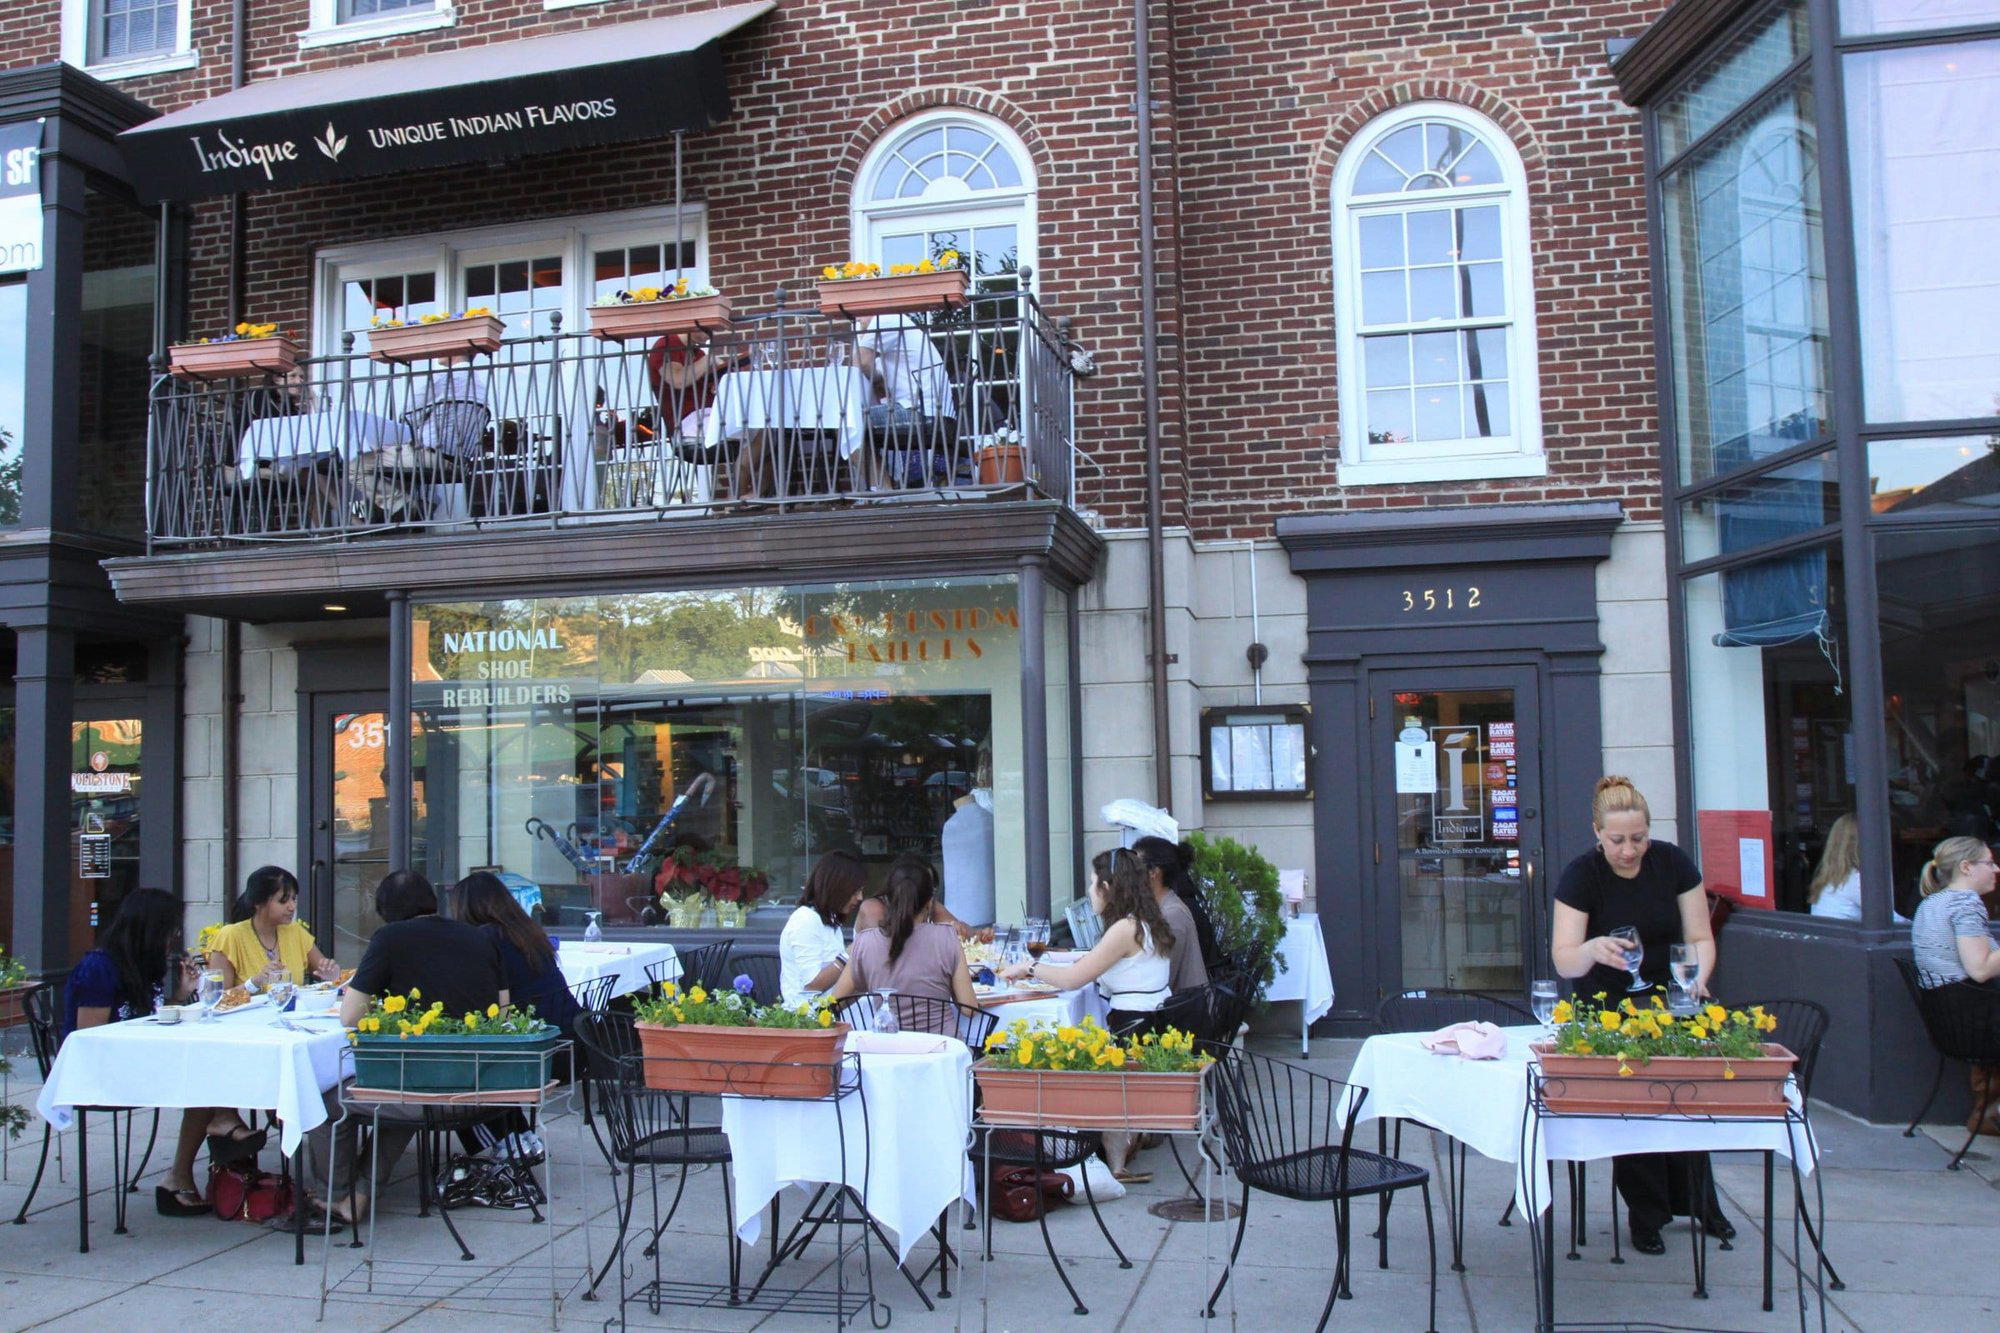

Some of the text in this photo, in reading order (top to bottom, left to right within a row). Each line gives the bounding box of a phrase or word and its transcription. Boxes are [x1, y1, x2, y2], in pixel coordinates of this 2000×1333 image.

[189, 98, 617, 181] Indique UNIQUE INDIAN FLAVORS
[6, 146, 37, 186] SF
[1402, 587, 1481, 611] 3512
[444, 628, 564, 653] NATIONAL
[478, 659, 532, 680] SHOE
[443, 684, 571, 708] REBUILDERS
[1490, 748, 1515, 756] RATED
[98, 773, 130, 788] STONE
[1492, 796, 1517, 804] RATED
[1437, 819, 1479, 839] Indique
[1493, 828, 1518, 836] RATED
